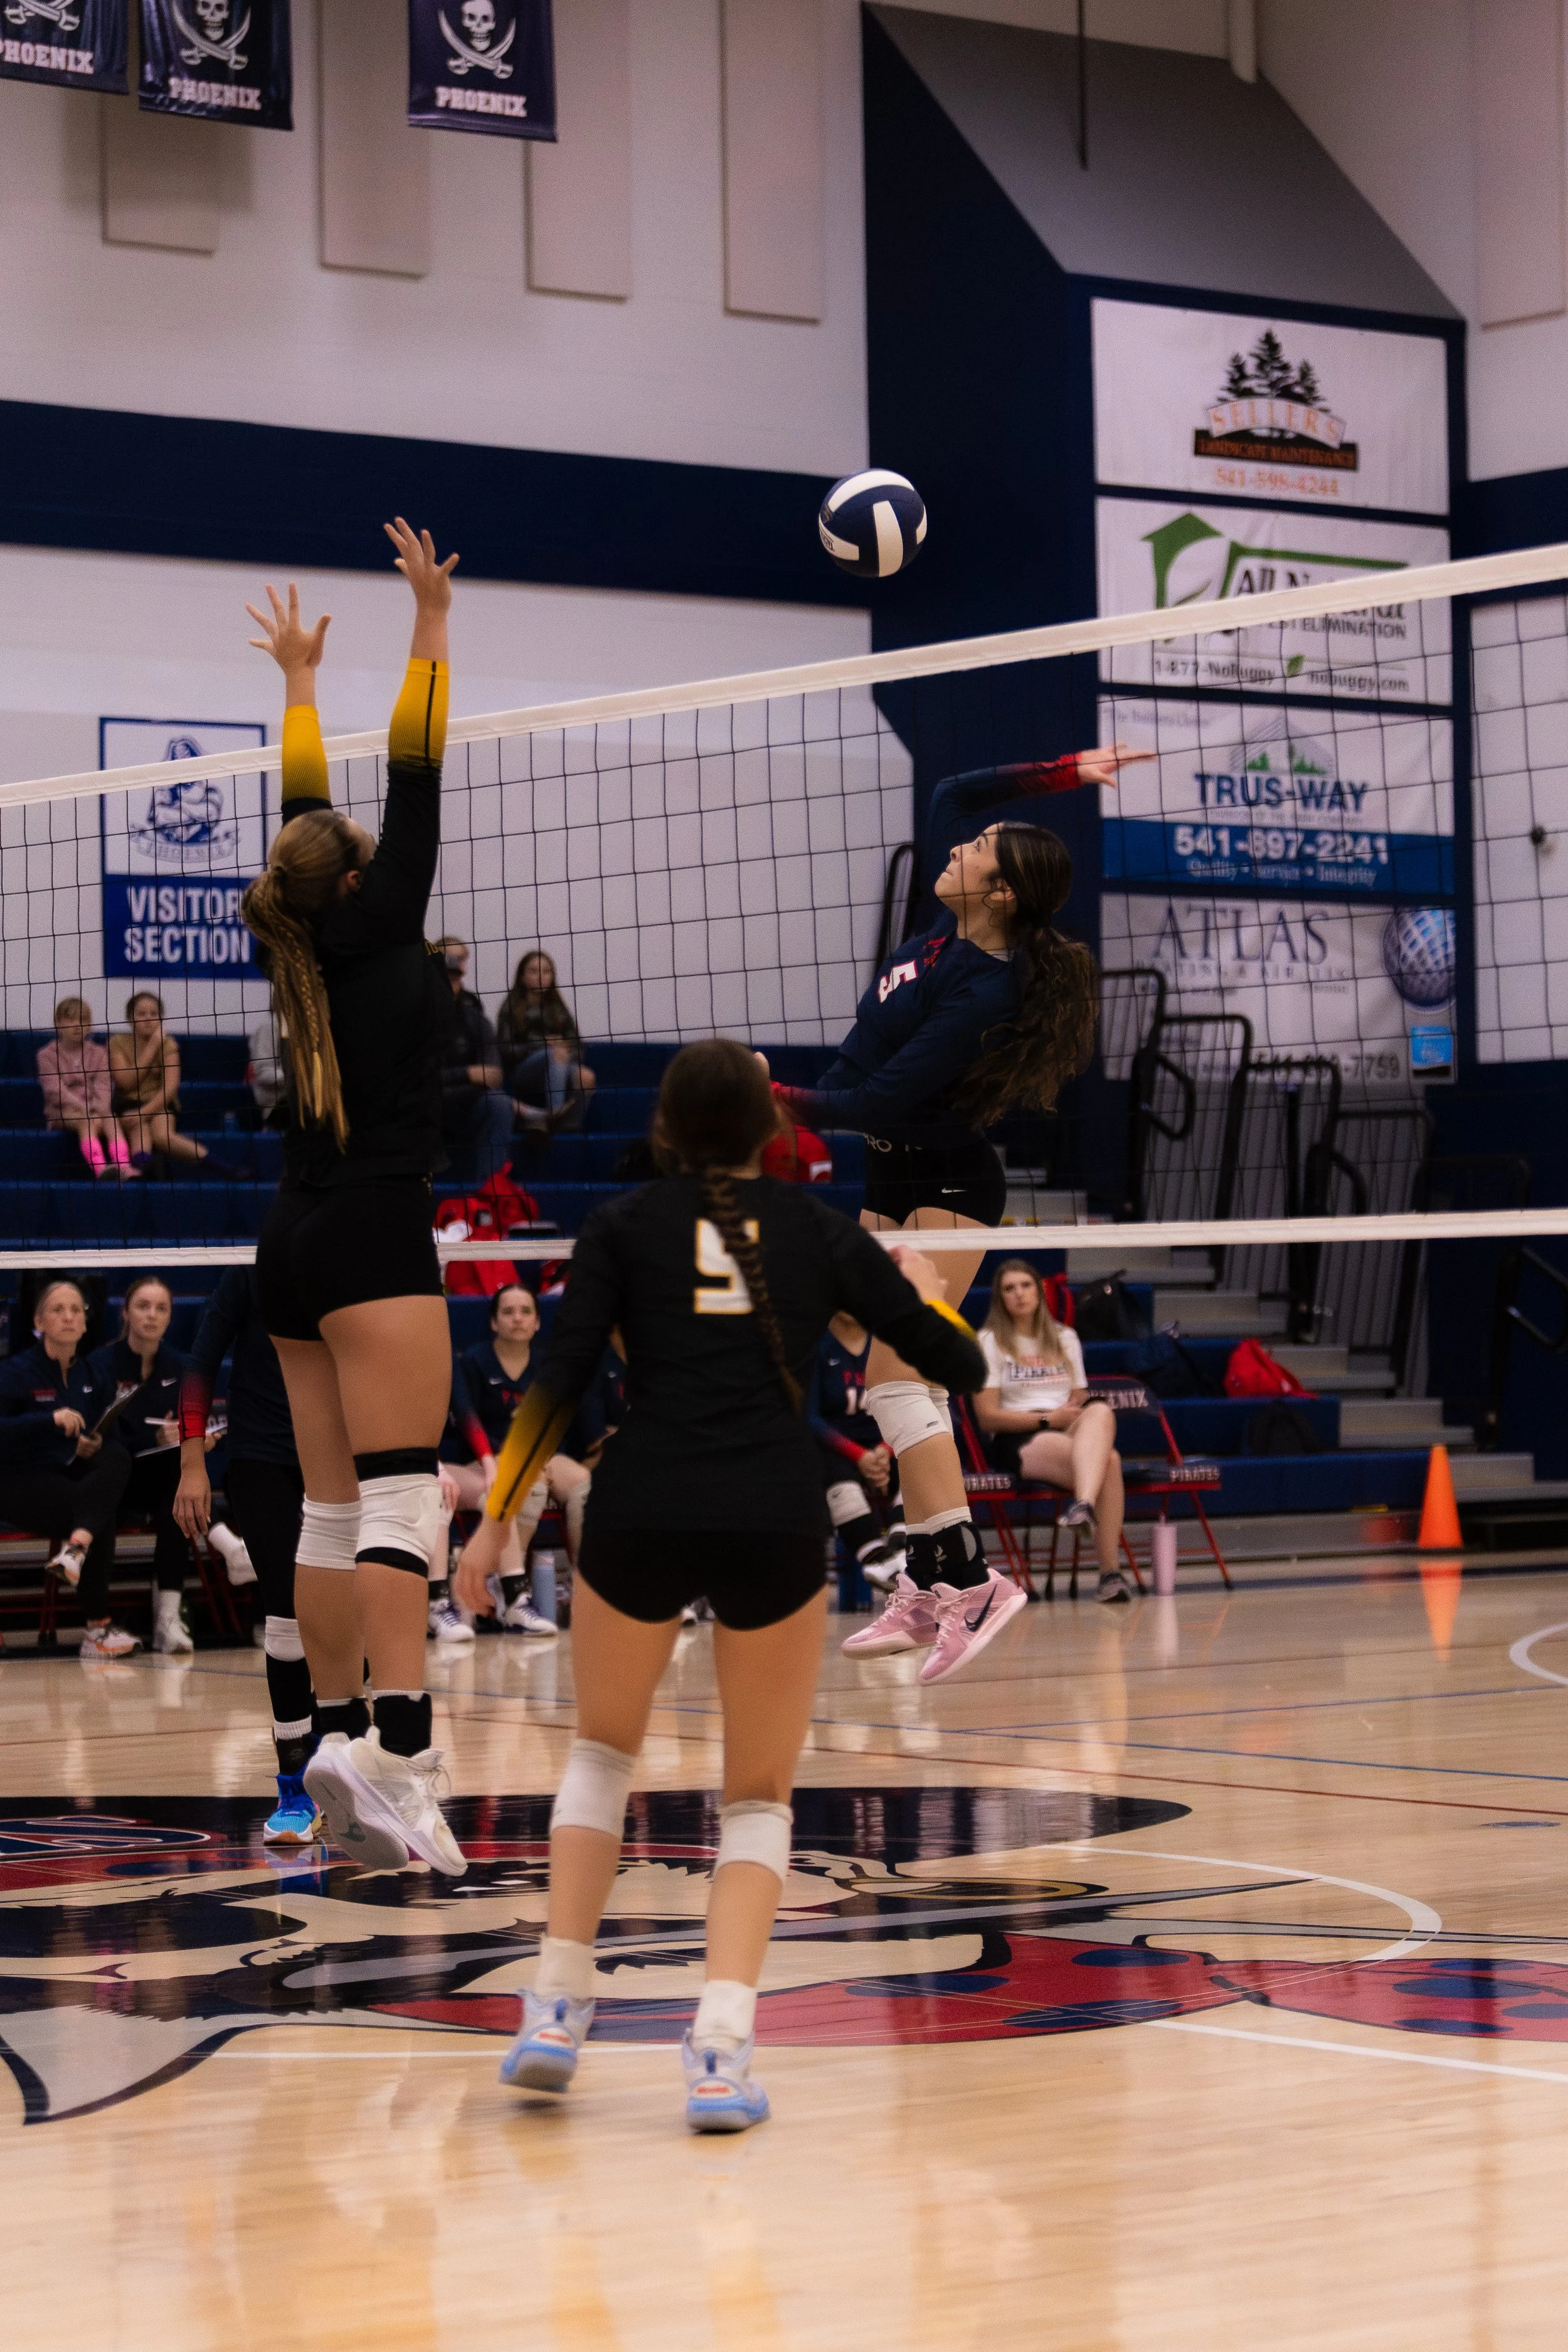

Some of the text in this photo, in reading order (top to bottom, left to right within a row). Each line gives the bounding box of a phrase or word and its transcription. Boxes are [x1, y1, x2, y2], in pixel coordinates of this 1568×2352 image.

[0, 38, 94, 75] HOENIX
[168, 76, 262, 111] PHOENIX
[435, 85, 527, 118] PHOENIX
[1238, 567, 1276, 594] All
[1302, 617, 1407, 639] ELIMINATION
[1194, 773, 1369, 812] TRUS-WAY
[127, 886, 245, 924] VISITOR
[124, 925, 250, 964] SECTION
[1152, 904, 1328, 965] ATLAS
[878, 959, 918, 1004] 5
[692, 1217, 761, 1315] 5
[965, 1475, 1012, 1491] IRATES
[1169, 1466, 1221, 1482] PIRATES
